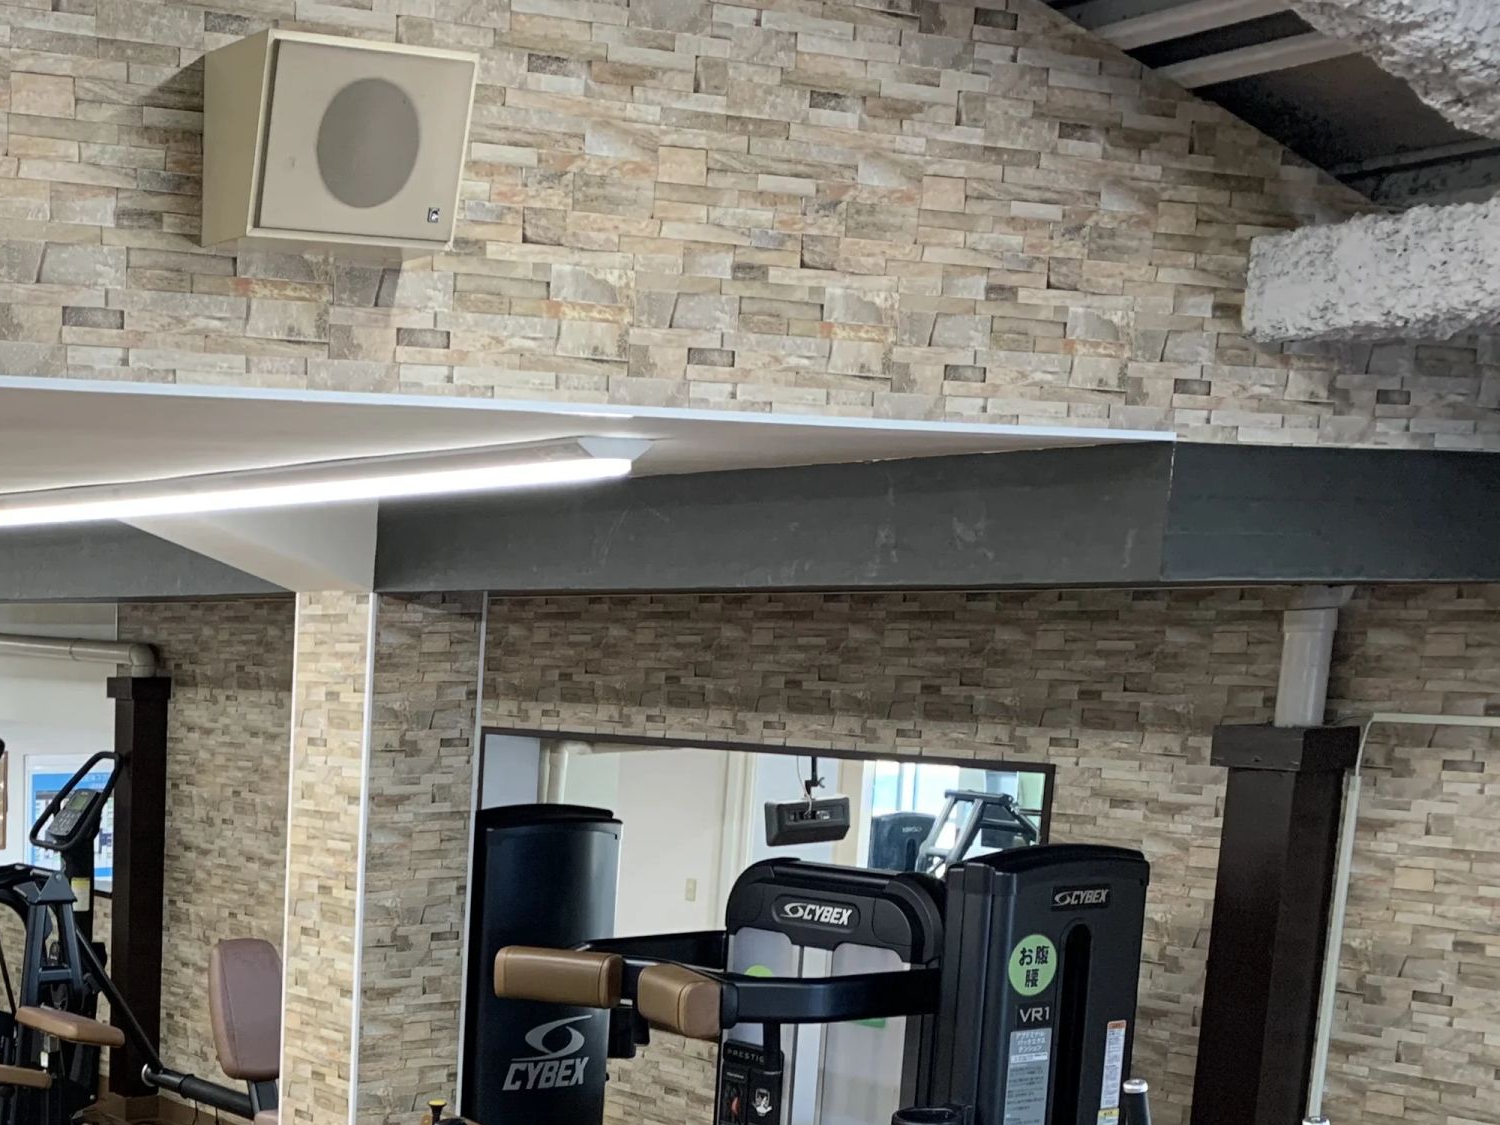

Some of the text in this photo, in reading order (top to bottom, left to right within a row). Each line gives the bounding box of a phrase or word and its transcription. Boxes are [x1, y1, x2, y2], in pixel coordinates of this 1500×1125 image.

[1070, 889, 1109, 905] CYBEX
[802, 904, 853, 926] CYBEX
[1018, 945, 1050, 967] お腹
[1024, 968, 1040, 988] 腰
[1019, 1006, 1050, 1023] VR1
[727, 1048, 765, 1063] PRESTIG
[502, 1056, 590, 1091] CYBEX
